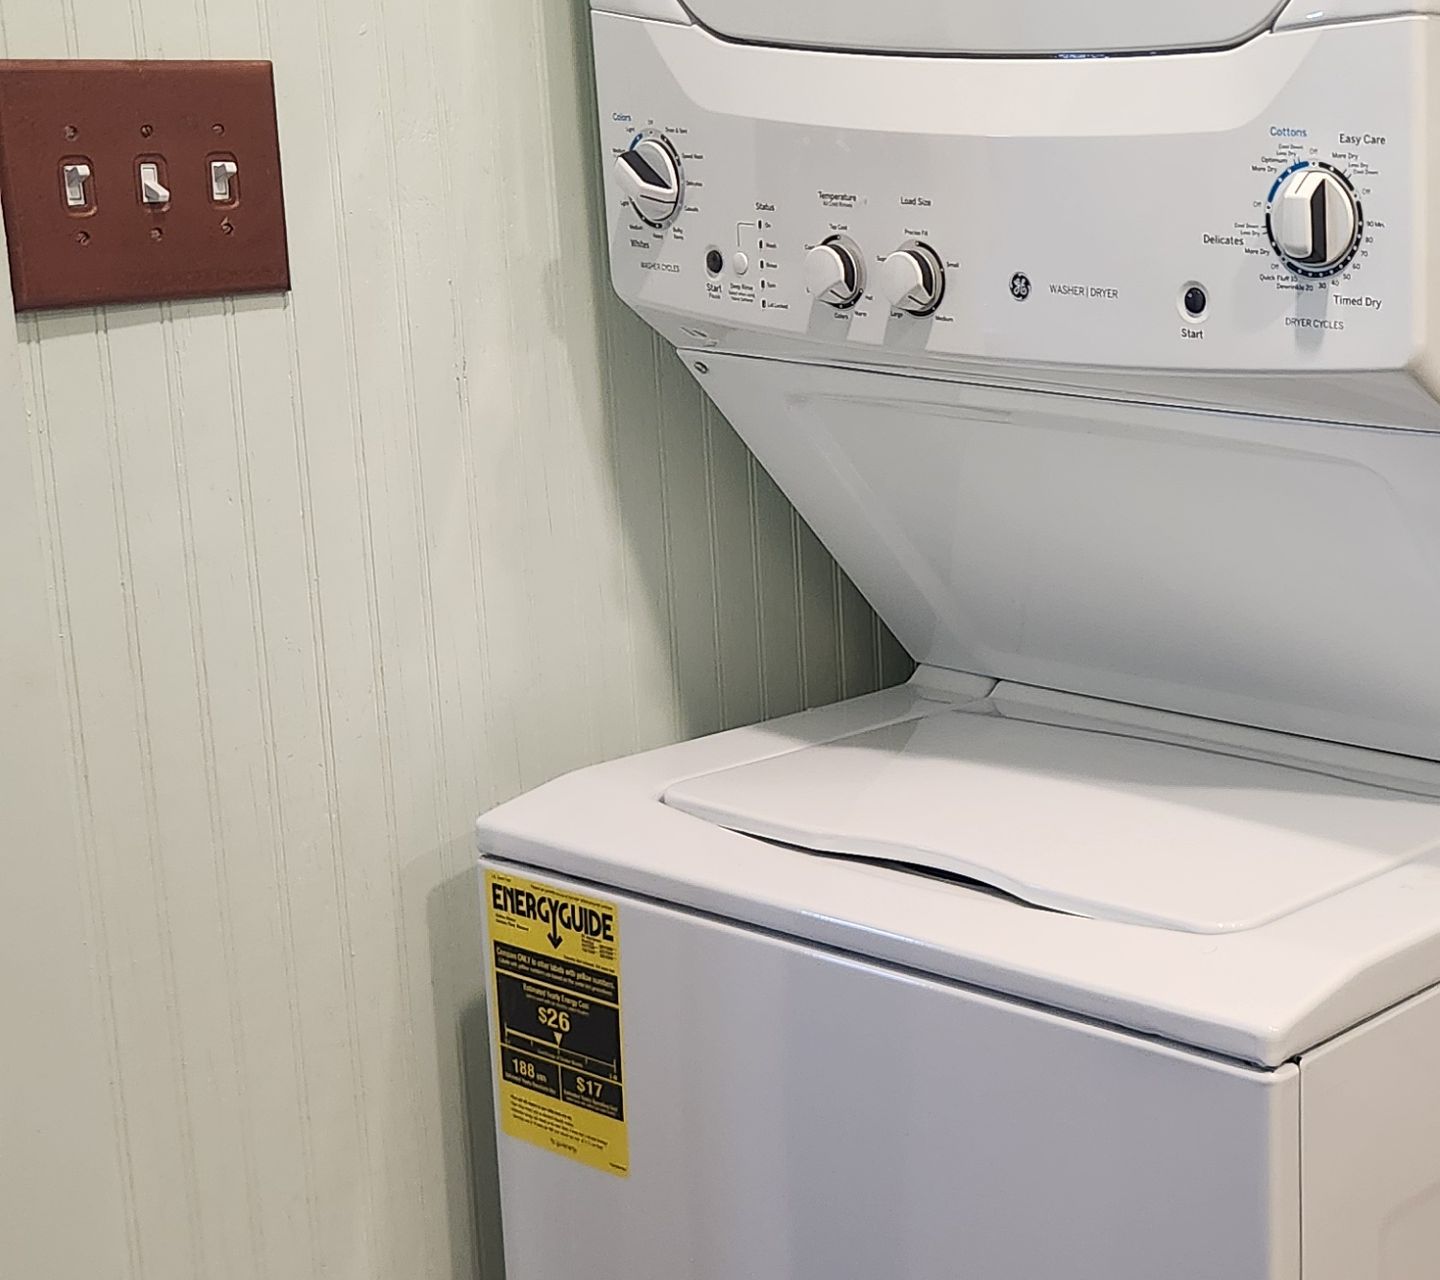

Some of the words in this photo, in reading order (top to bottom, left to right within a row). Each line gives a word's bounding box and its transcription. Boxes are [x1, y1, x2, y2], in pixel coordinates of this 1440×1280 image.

[1270, 126, 1307, 137] Cottons
[1340, 134, 1361, 145] Easy
[1363, 134, 1386, 144] Care
[1348, 152, 1358, 160] Dry
[1267, 166, 1277, 174] Dry
[818, 191, 857, 202] Temperature
[900, 197, 916, 205] Load
[918, 198, 931, 206] Size
[755, 202, 775, 211] Status
[1203, 234, 1244, 246] Delicates
[1260, 248, 1270, 256] Dry
[706, 283, 722, 293] Start
[1050, 284, 1084, 296] WASHER
[1090, 287, 1118, 299] DRYER
[1334, 295, 1362, 306] Timed
[1365, 297, 1382, 310] Dry
[1285, 317, 1311, 328] DRYER
[1314, 318, 1344, 330] CYCLES
[1181, 328, 1203, 339] Start
[492, 882, 614, 942] ENERGYGUIDE
[538, 1006, 570, 1032] $26
[512, 1058, 535, 1078] 188
[576, 1077, 602, 1097] $17
